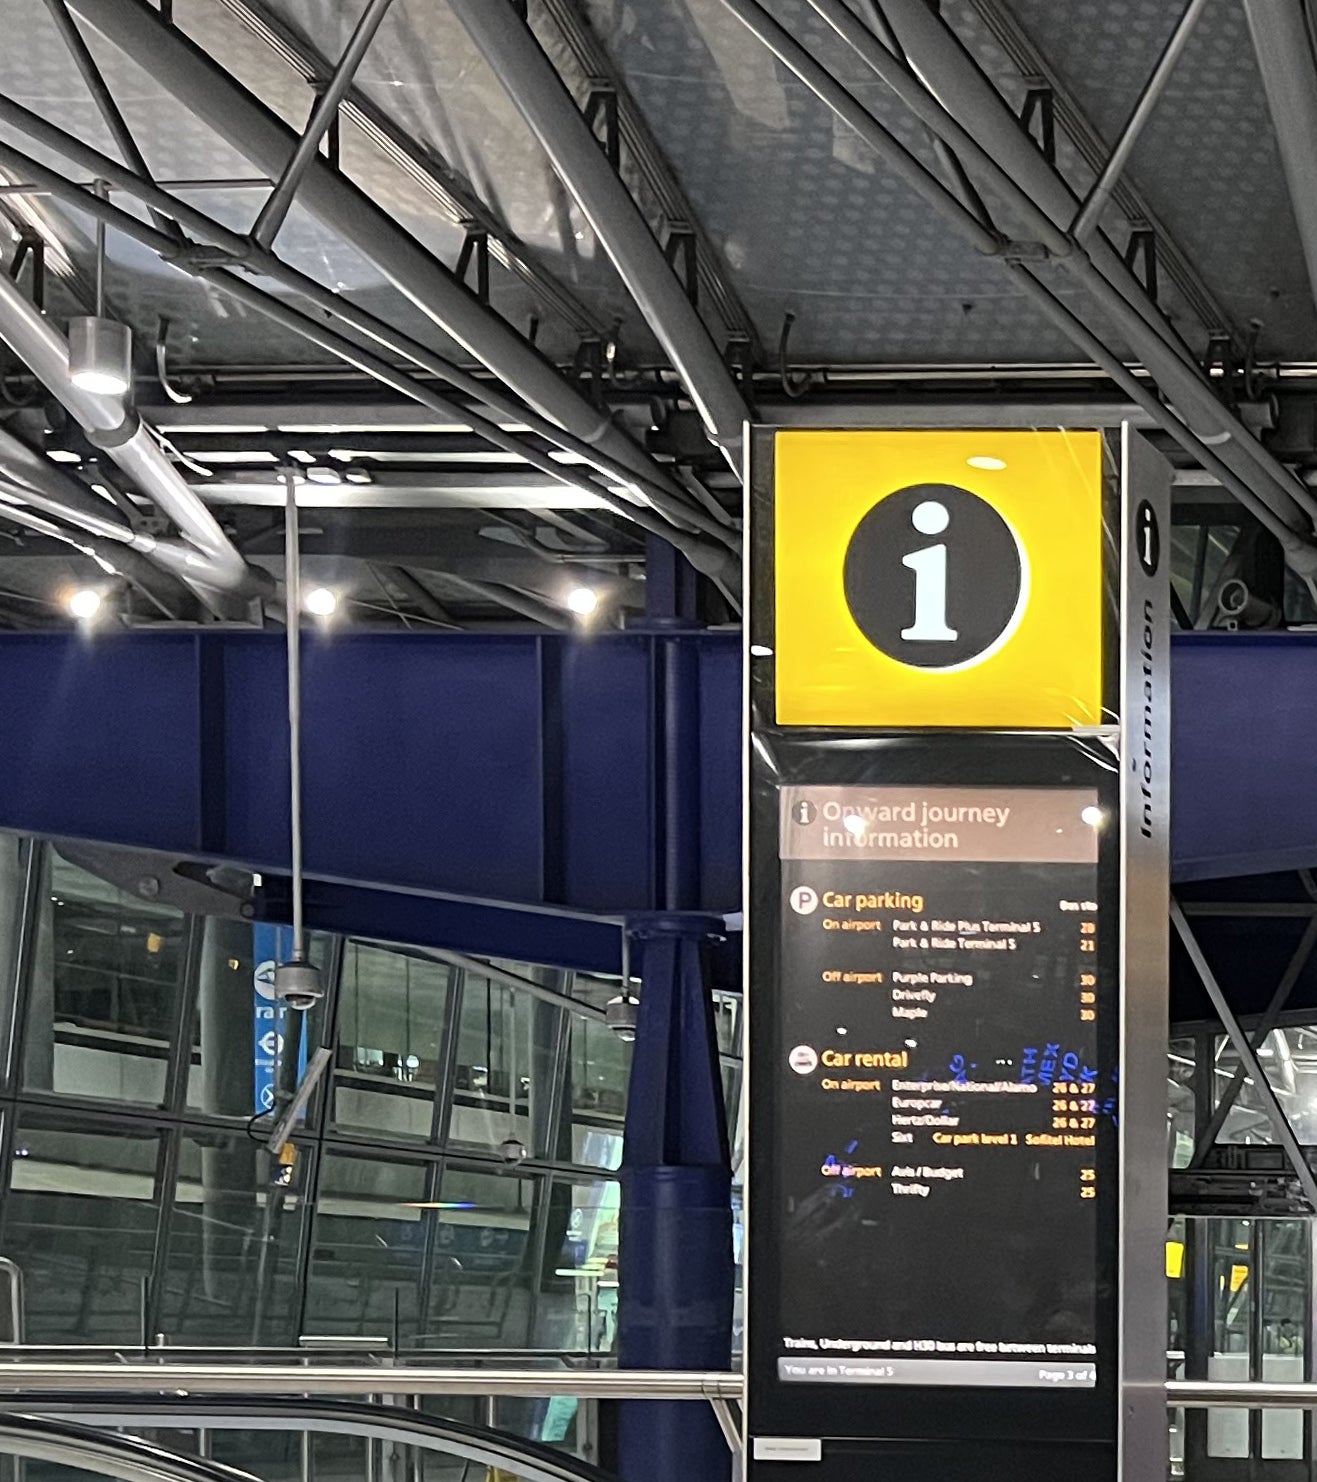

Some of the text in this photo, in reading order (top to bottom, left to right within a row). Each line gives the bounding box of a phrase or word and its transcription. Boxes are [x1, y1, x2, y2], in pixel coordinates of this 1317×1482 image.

[1132, 600, 1155, 839] Information
[919, 801, 1010, 828] journey
[822, 892, 924, 913] Car parking
[822, 919, 882, 933] On airport
[893, 919, 918, 932] Park
[919, 921, 929, 932] &
[931, 920, 956, 933] Ride
[957, 920, 980, 934] Plus
[981, 921, 1031, 934] Terminal
[893, 936, 918, 949] Park
[919, 938, 929, 949] &
[931, 937, 956, 949] Ride
[957, 937, 1007, 950] Terminal
[1080, 939, 1095, 952] 21
[822, 971, 883, 985] Off airport
[893, 972, 973, 987] Purple Parking
[821, 1050, 909, 1068] Car rental
[821, 1078, 881, 1093] On airport
[892, 1097, 943, 1112] Europcar
[932, 1132, 953, 1145] Car
[953, 1132, 982, 1147] park
[982, 1133, 1010, 1146] level
[1025, 1133, 1062, 1147] Sofitel
[1063, 1134, 1096, 1147] Hotel
[841, 1165, 882, 1180] airport
[922, 1166, 964, 1181] Budget
[891, 1183, 931, 1198] Thrifty
[784, 1337, 818, 1351] Trains,
[819, 1338, 890, 1354] Underground
[891, 1340, 912, 1352] and
[936, 1340, 955, 1353] bus
[956, 1342, 974, 1353] are
[975, 1341, 998, 1354] free
[998, 1342, 1046, 1354] between
[1046, 1343, 1097, 1355] terminals
[784, 1364, 805, 1377] You
[806, 1366, 825, 1377] are
[839, 1365, 884, 1378] Terminal
[1038, 1369, 1065, 1382] Page
[1075, 1369, 1087, 1381] of
